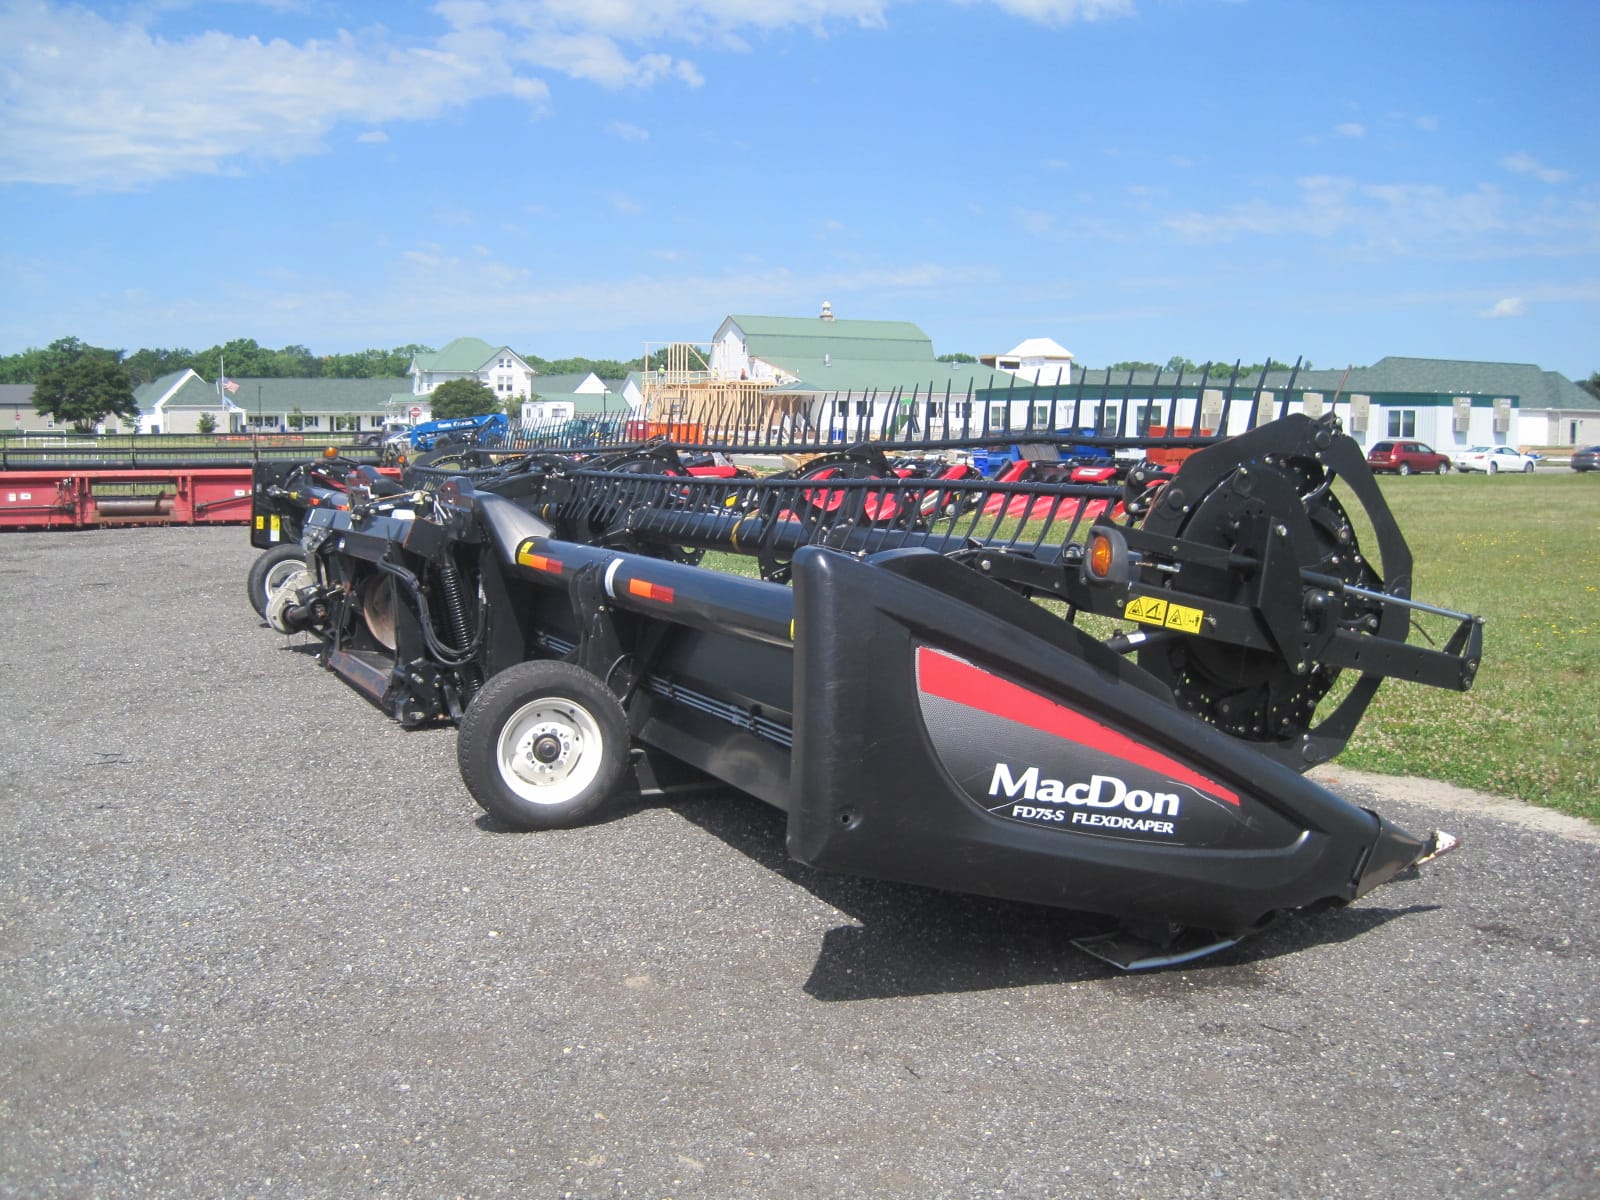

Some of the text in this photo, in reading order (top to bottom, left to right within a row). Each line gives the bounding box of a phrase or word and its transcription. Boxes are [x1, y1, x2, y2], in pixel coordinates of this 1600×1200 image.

[988, 762, 1180, 816] MacDon
[1012, 805, 1175, 834] FD75-S FLEXDRAPER
